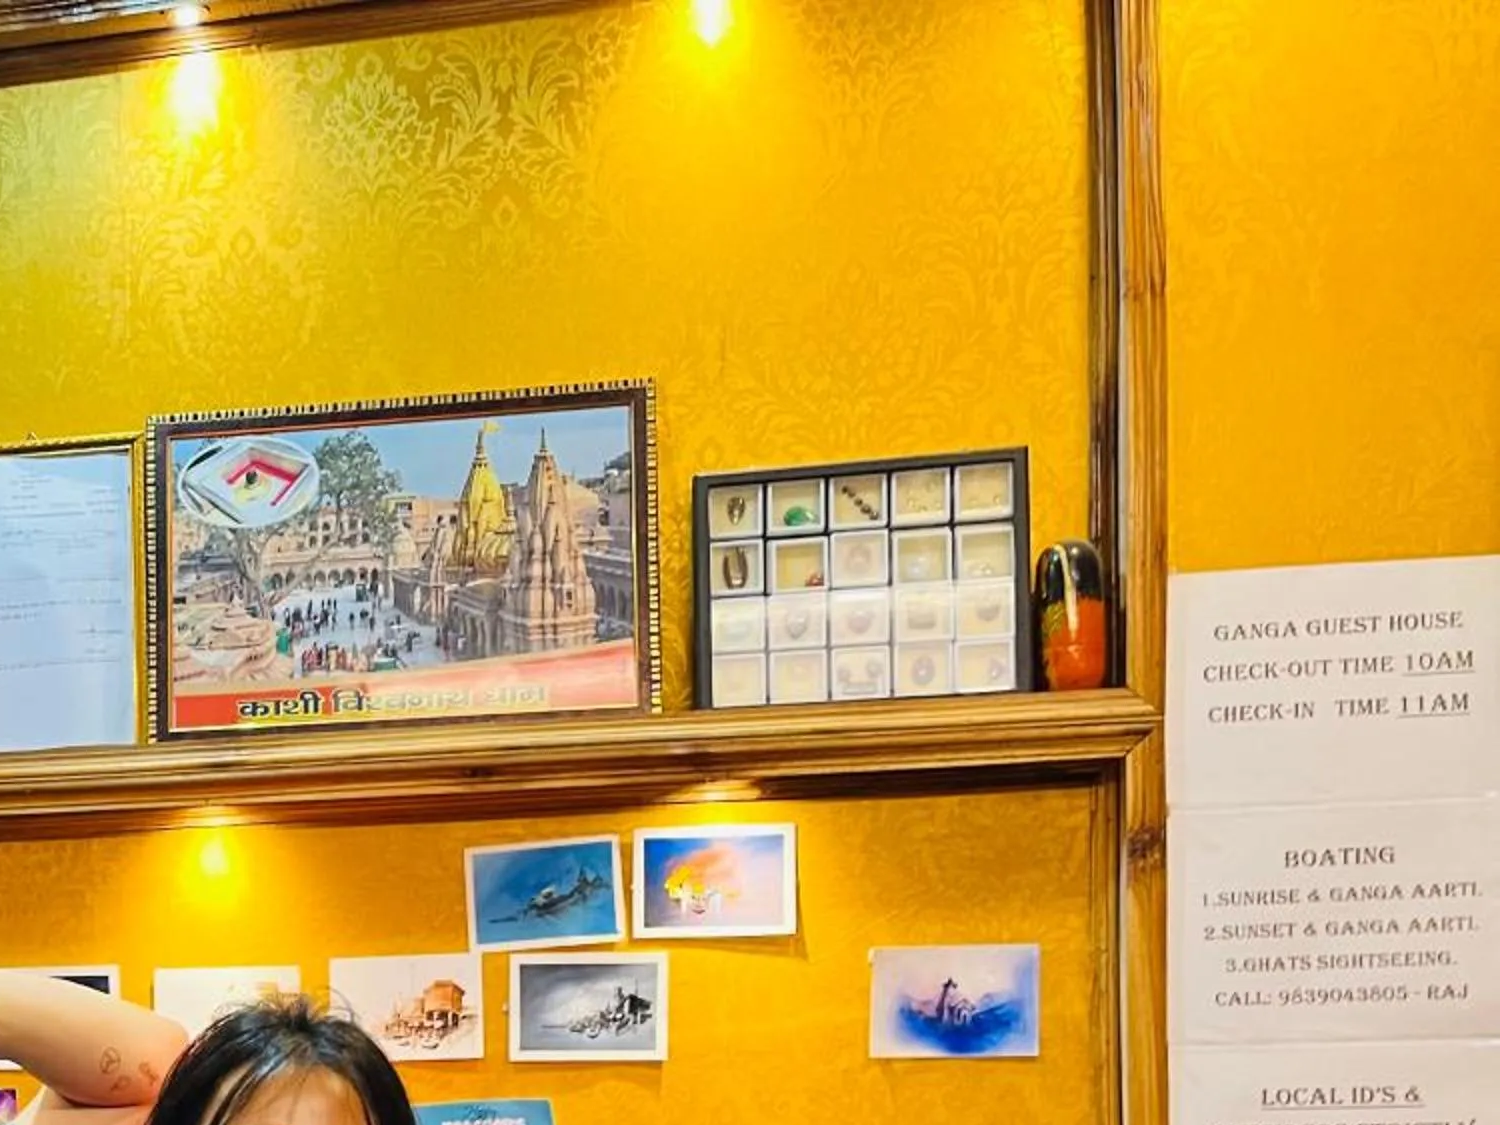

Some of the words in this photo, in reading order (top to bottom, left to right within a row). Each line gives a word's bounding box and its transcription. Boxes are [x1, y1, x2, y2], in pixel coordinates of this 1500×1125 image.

[1213, 621, 1298, 642] GANGA
[1306, 616, 1382, 636] GUEST
[1389, 611, 1463, 632] HOUSE
[1203, 659, 1332, 683] CHECK-OUT
[1339, 656, 1394, 676] TIME
[1405, 650, 1475, 673] 10AM
[238, 689, 321, 717] काशी
[1208, 701, 1315, 724] CHECK-IN
[1335, 697, 1390, 717] TIME
[1401, 693, 1470, 714] 11AM
[1284, 846, 1396, 868] BOATING
[1307, 888, 1321, 902] &
[1329, 885, 1403, 903] GANGA
[1303, 921, 1317, 937] &
[1325, 918, 1400, 936] GANGA
[1225, 955, 1311, 974] 3.GHATS
[1427, 983, 1469, 1001] RAJ
[1261, 1087, 1344, 1106] LOCAL
[1351, 1085, 1396, 1103] ID'S
[1404, 1085, 1421, 1102] &
